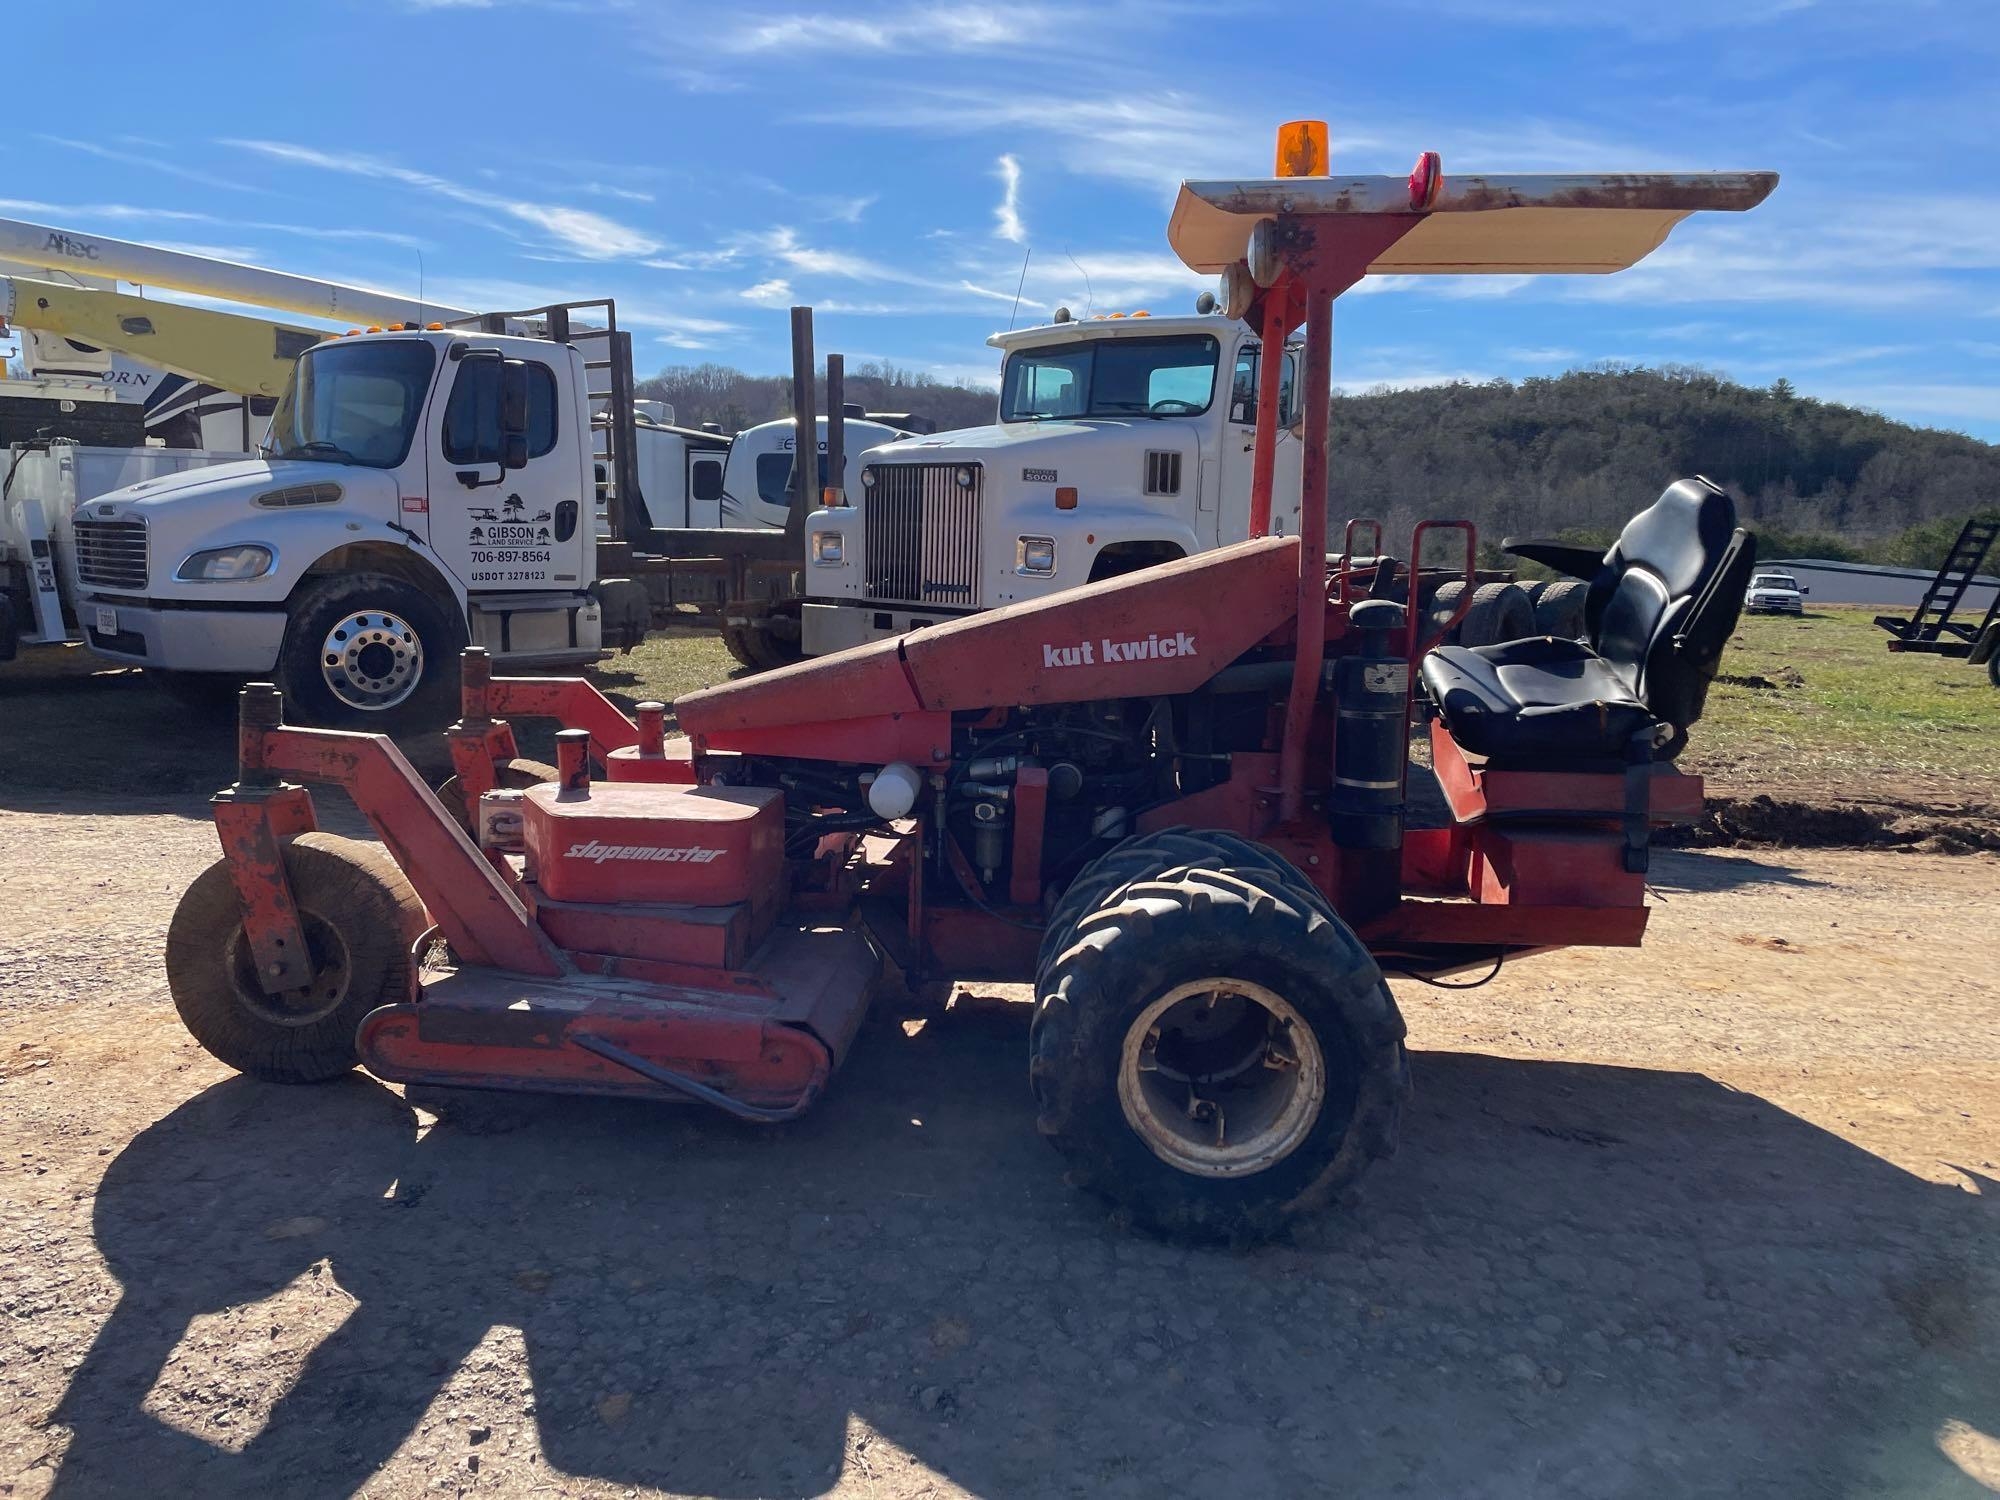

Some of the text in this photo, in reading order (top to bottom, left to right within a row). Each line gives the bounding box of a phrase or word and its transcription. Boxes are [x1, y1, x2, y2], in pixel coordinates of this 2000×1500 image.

[42, 233, 101, 260] Altec
[488, 527, 534, 538] GIBSON
[471, 551, 551, 562] 706-897-8564
[471, 571, 545, 580] USDOT 3278123
[1043, 632, 1198, 668] kut kwick
[563, 840, 728, 864] slopemaster
